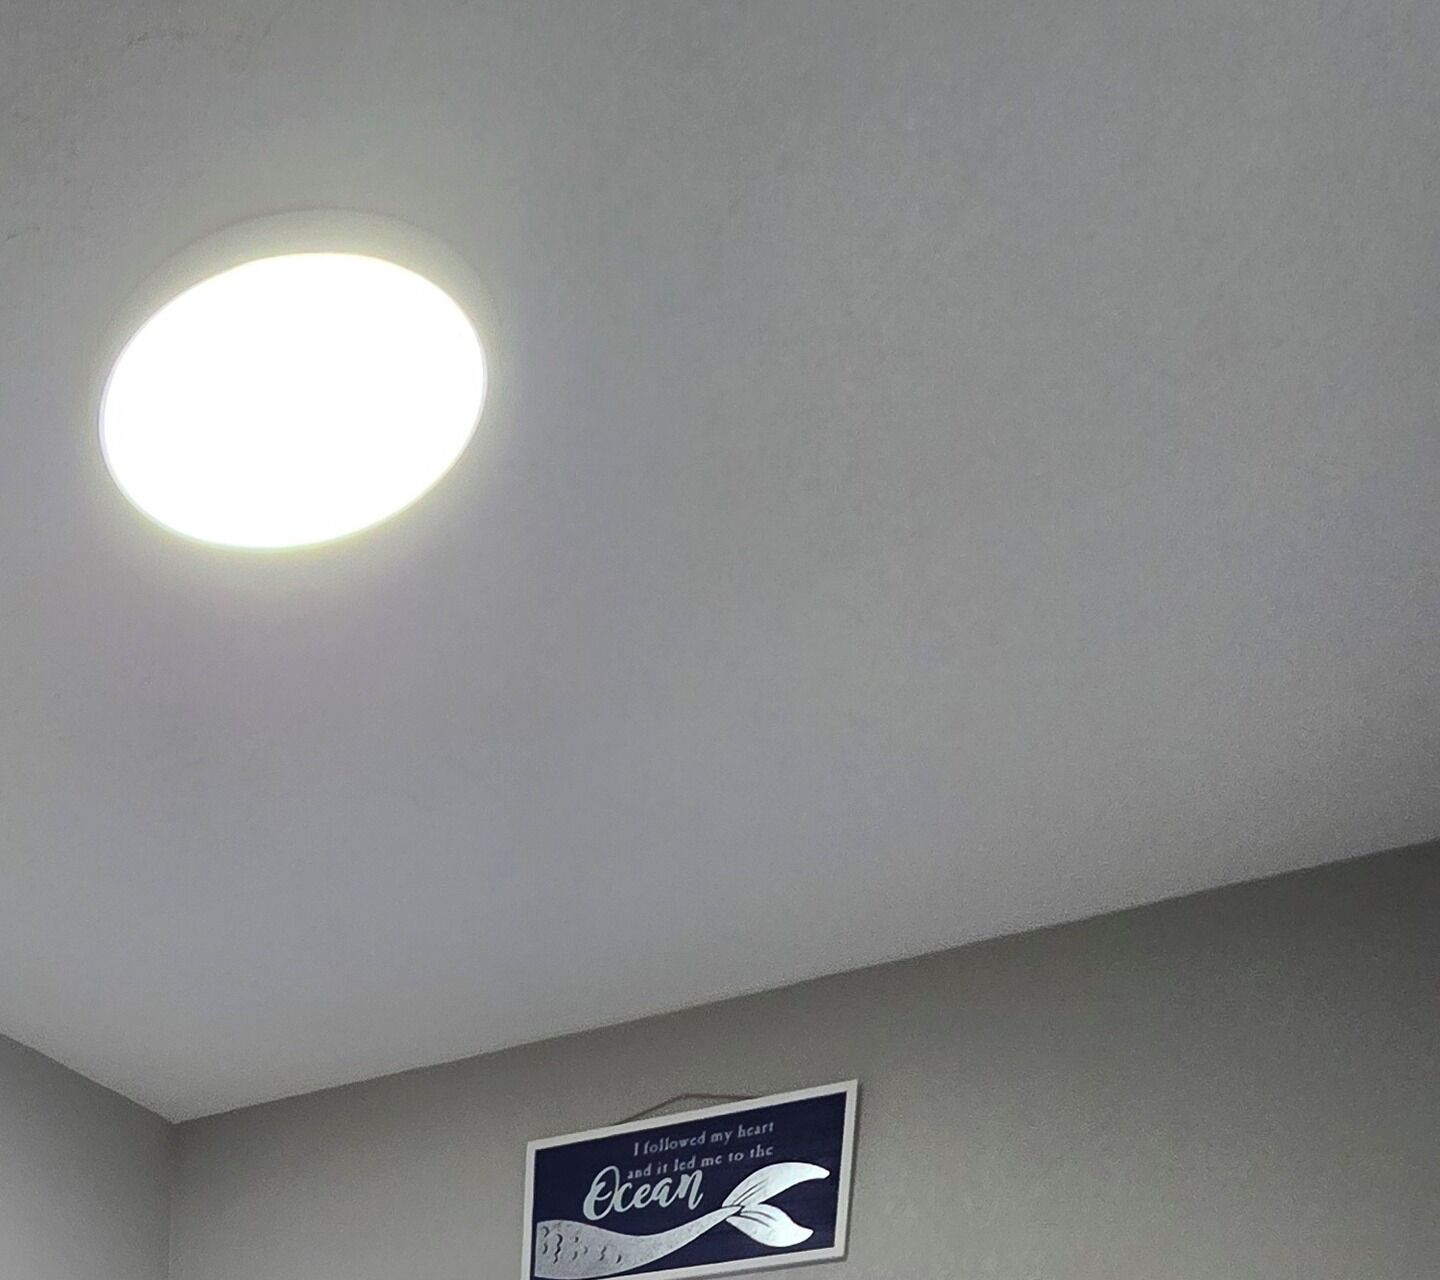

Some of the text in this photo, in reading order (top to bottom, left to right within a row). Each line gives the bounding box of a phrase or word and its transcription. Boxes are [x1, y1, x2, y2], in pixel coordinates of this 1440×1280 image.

[633, 1121, 775, 1156] I followed my heart
[626, 1143, 774, 1179] and it led me to the
[582, 1165, 704, 1220] Ocean
